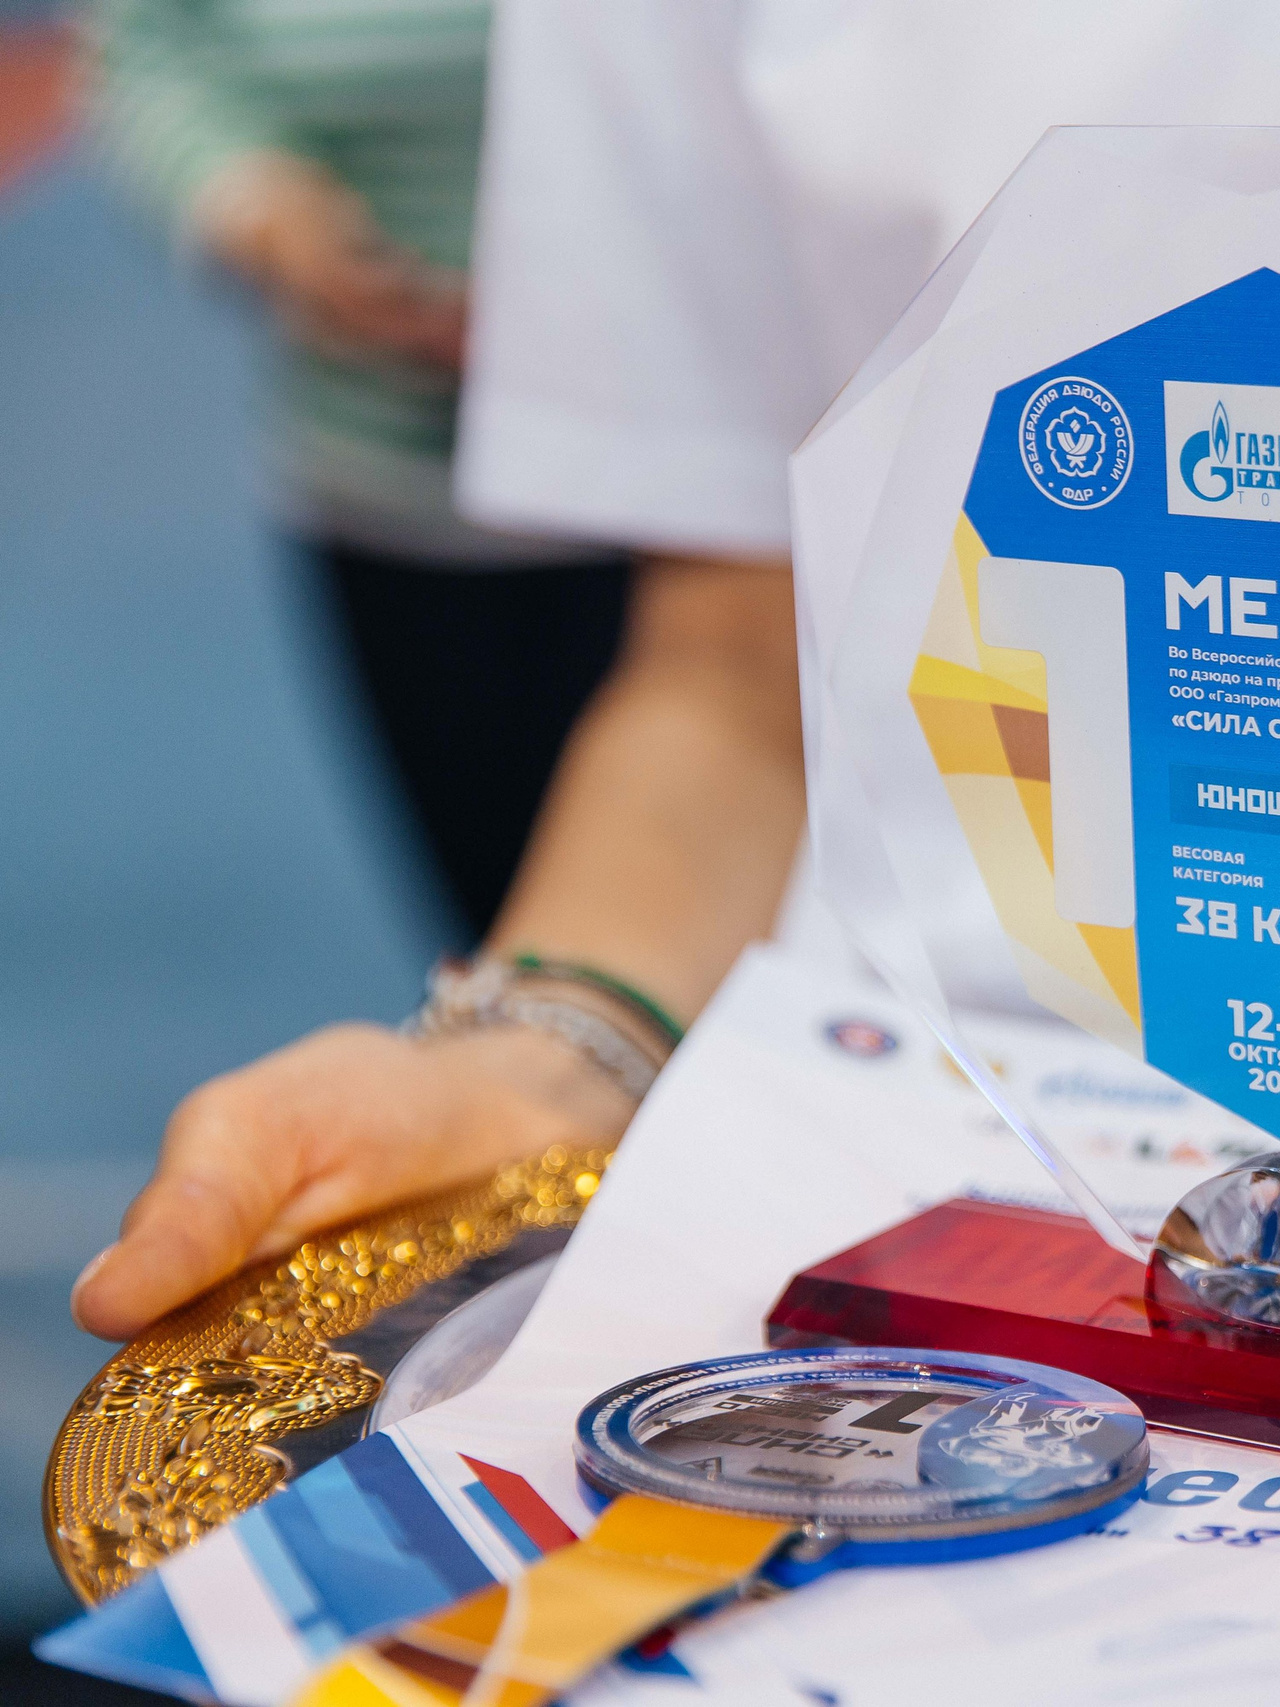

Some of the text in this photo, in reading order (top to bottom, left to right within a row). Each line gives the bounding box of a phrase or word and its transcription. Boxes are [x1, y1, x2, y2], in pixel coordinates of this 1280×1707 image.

[1026, 384, 1127, 481] ФЕДЕРАЦИЯ ДЗЮДО РОССИИ
[1062, 487, 1094, 501] ФДР
[1168, 645, 1188, 659] Во
[1169, 667, 1188, 679] по
[1191, 669, 1241, 685] дзюдо
[1245, 674, 1263, 686] на
[1169, 685, 1204, 700] ООО
[1208, 689, 1280, 709] «Газпром
[1171, 710, 1261, 737] «СИЛА
[977, 556, 1136, 929] 1
[1172, 845, 1245, 866] ВЕСОВАЯ
[1172, 866, 1264, 889] КАТЕГОРИЯ
[1175, 896, 1237, 939] 38
